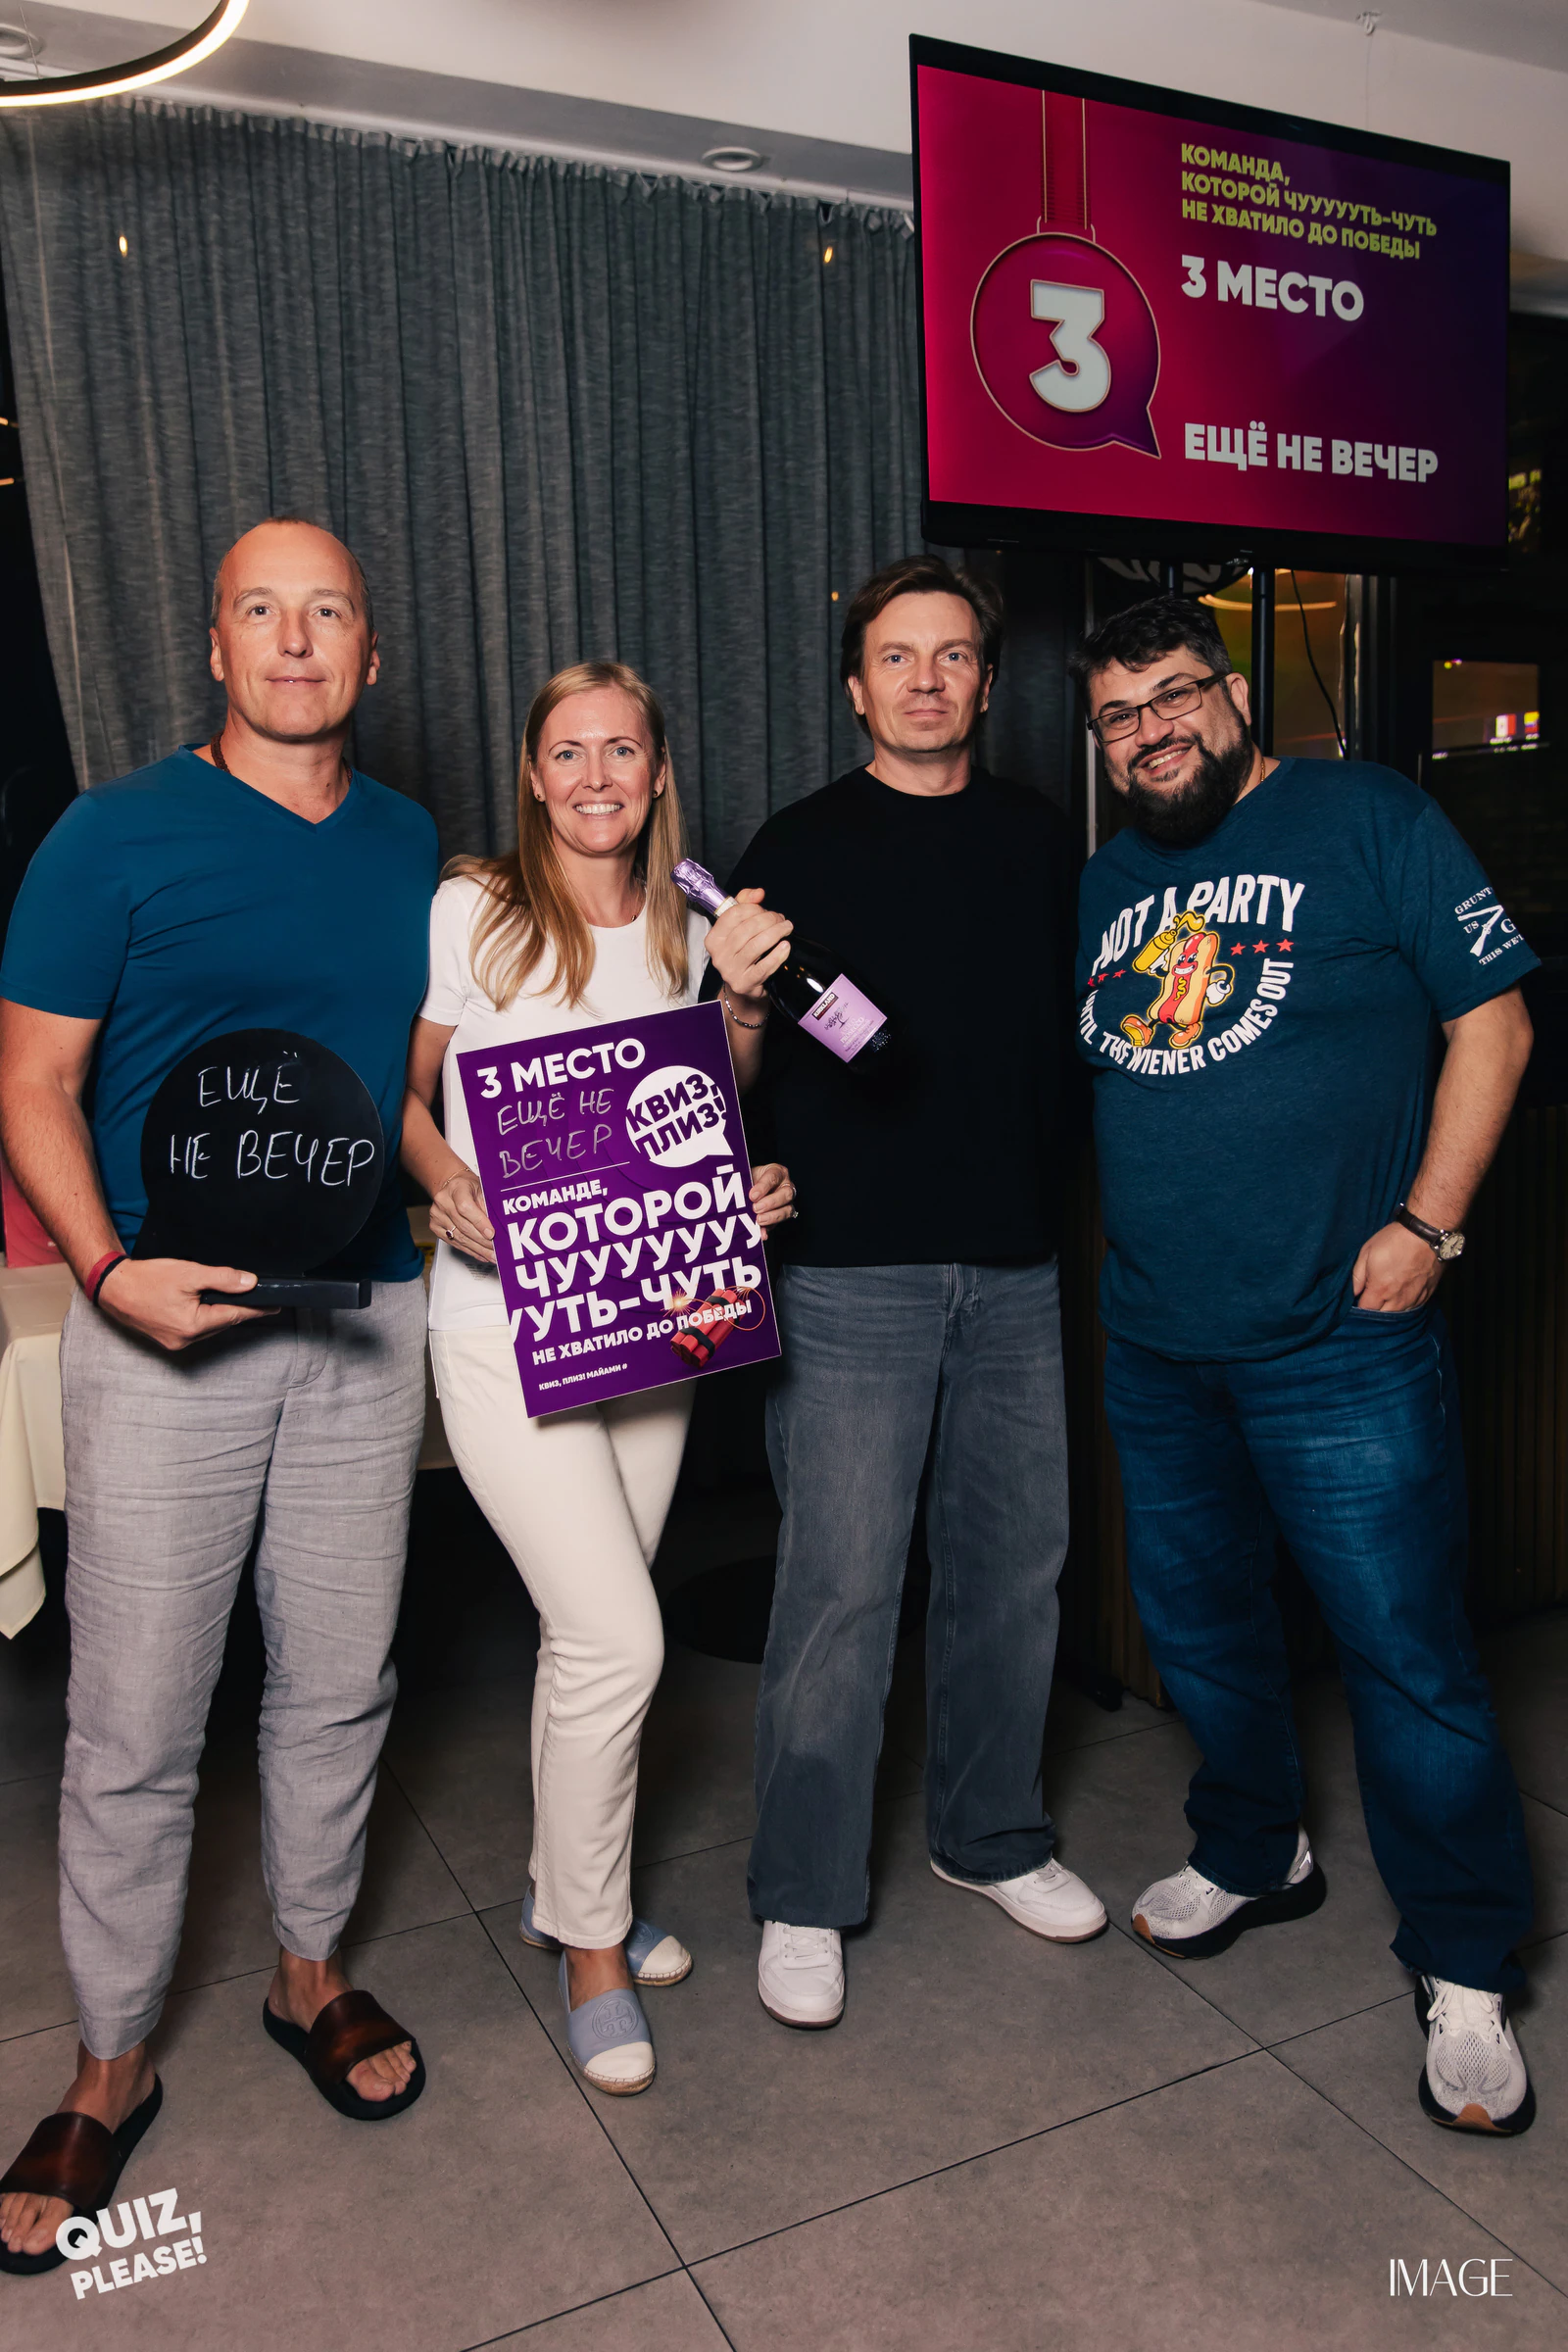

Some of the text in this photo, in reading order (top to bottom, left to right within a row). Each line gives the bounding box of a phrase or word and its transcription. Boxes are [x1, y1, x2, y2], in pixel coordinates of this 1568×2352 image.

[1182, 143, 1291, 185] КОМАНДА,
[1182, 171, 1438, 236] КОТОРОЙ ЧУУУУУТЬ-ЧУТЬ
[1182, 199, 1420, 261] НЕ ХВАТИЛО ДО ПОБЕДЫ
[1181, 254, 1364, 321] 3 МЕСТО
[1029, 279, 1111, 413] 3
[1185, 419, 1439, 483] ЕЩЁ НЕ ВЕЧЕР
[1091, 874, 1305, 977] NOT A PARTY
[1454, 887, 1493, 914] GRUNT
[1463, 921, 1479, 933] US
[1479, 948, 1502, 965] THIS
[812, 993, 836, 1018] KIRKLAND
[1099, 1030, 1133, 1065] THE
[1126, 1045, 1206, 1075] WIENER
[1207, 998, 1278, 1061] COMES
[1256, 957, 1295, 1001] OUT
[198, 1051, 300, 1114] ЕЩЁ
[476, 1038, 646, 1099] 3 МЕСТО
[497, 1088, 614, 1136] ЕЩЁ НЕ
[626, 1074, 719, 1134] КВИЗ,
[635, 1096, 727, 1160] ПЛИЗ!
[171, 1129, 375, 1187] НЕ ВЕЧЕР
[499, 1123, 612, 1179] ВЕЧЕР
[502, 1179, 609, 1215] КОМАНДЕ,
[507, 1164, 747, 1260] КОТОРОЙ
[532, 1299, 753, 1366] НЕ ХВАТИЛО ДО ПОБЕДЫ
[538, 1379, 563, 1391] КВИЗ,
[562, 1373, 586, 1386] ПЛИЗ!
[586, 1363, 621, 1380] МАЙАМИ
